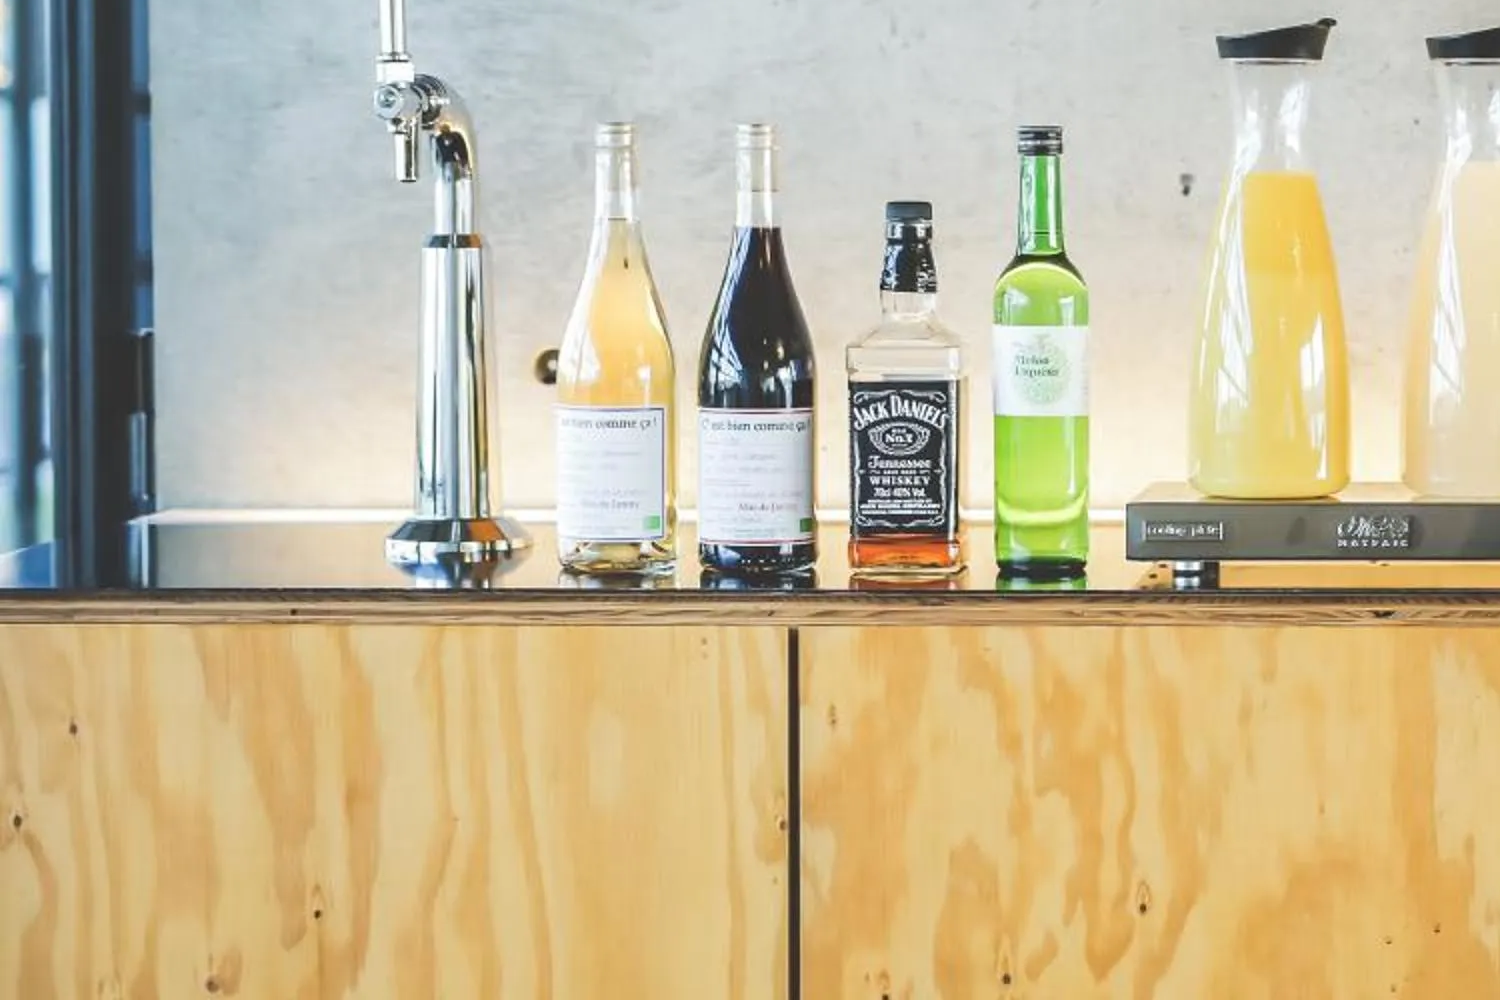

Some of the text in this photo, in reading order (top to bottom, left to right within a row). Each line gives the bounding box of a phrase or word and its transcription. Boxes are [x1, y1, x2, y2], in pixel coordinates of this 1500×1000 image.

[853, 394, 950, 430] JACK DANIEL'S
[595, 419, 637, 429] comme
[727, 419, 750, 431] bien
[753, 421, 794, 432] comme
[869, 475, 930, 485] WHISKEY
